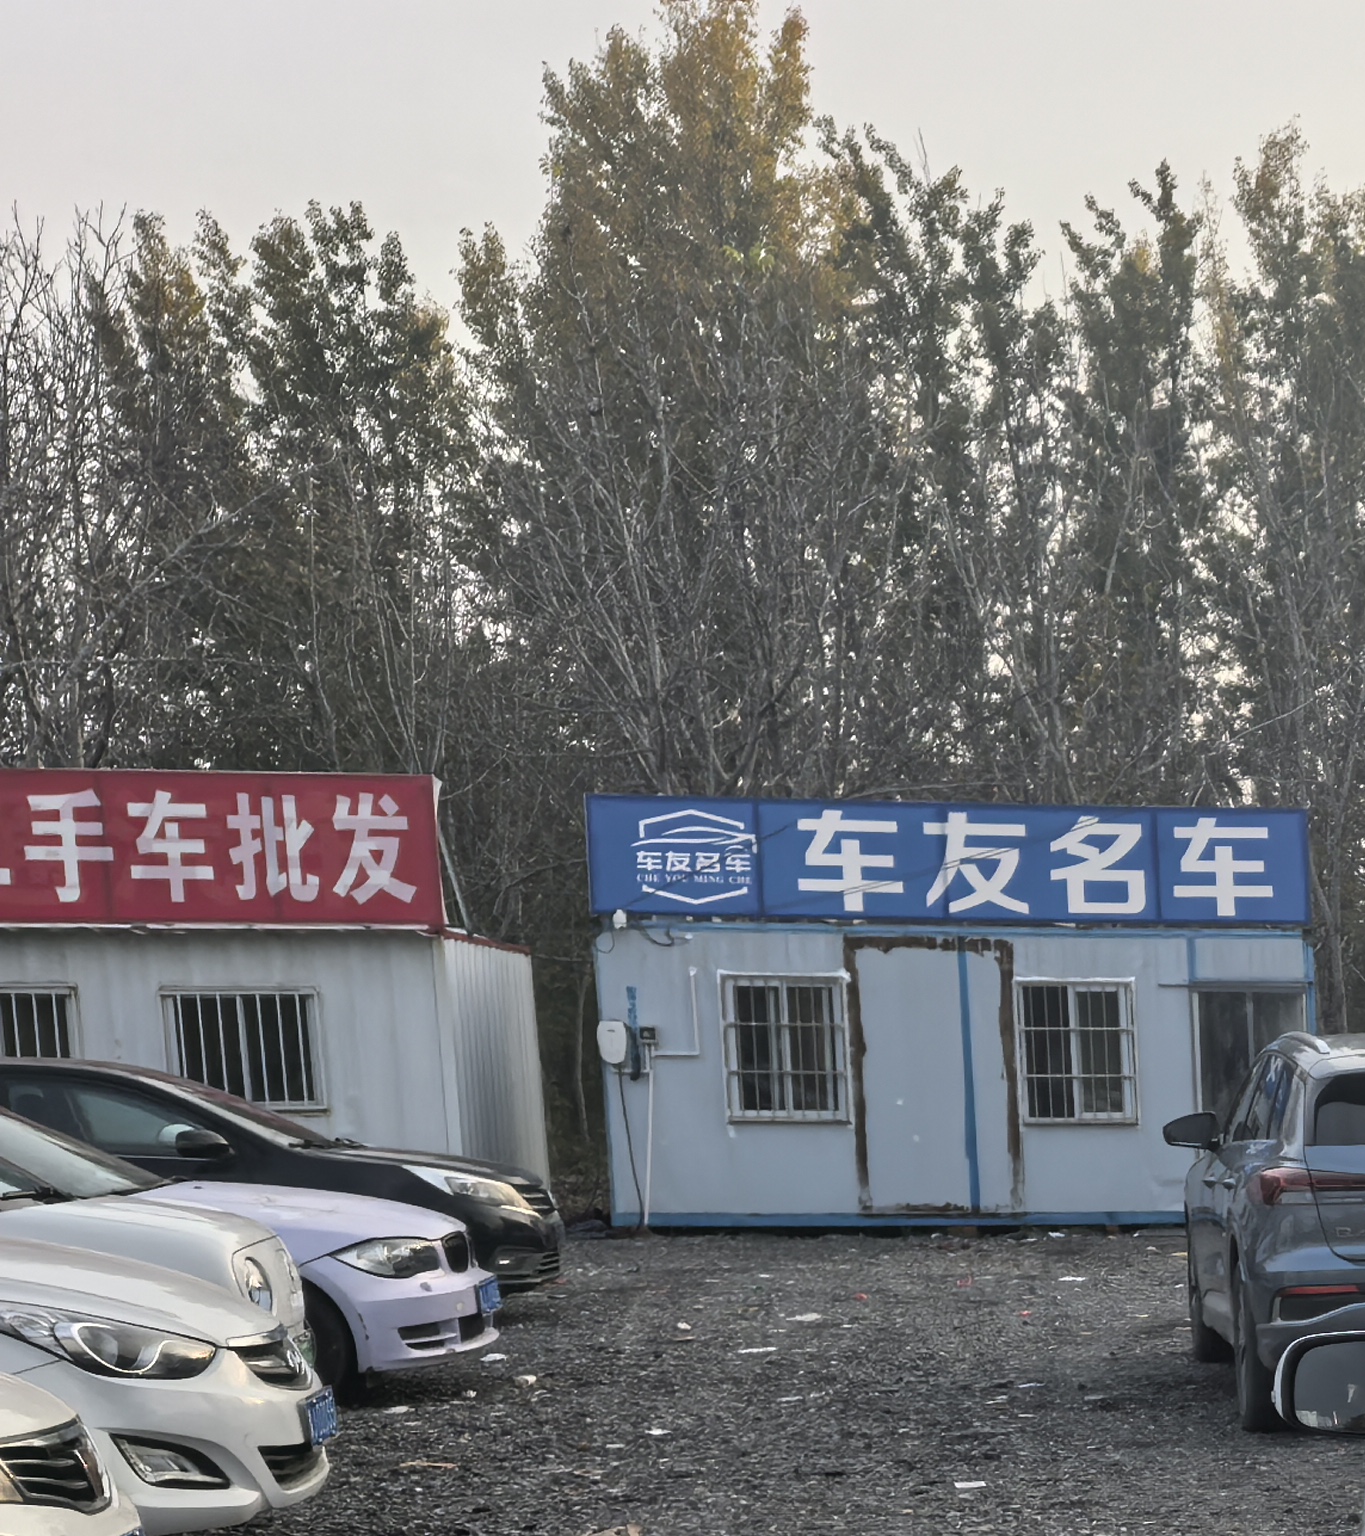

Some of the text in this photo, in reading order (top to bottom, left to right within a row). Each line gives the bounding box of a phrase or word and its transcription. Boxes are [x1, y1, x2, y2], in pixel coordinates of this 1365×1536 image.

[0, 788, 417, 904] 手车批发
[636, 850, 752, 873] 车友名车
[797, 809, 1274, 916] 车友名车
